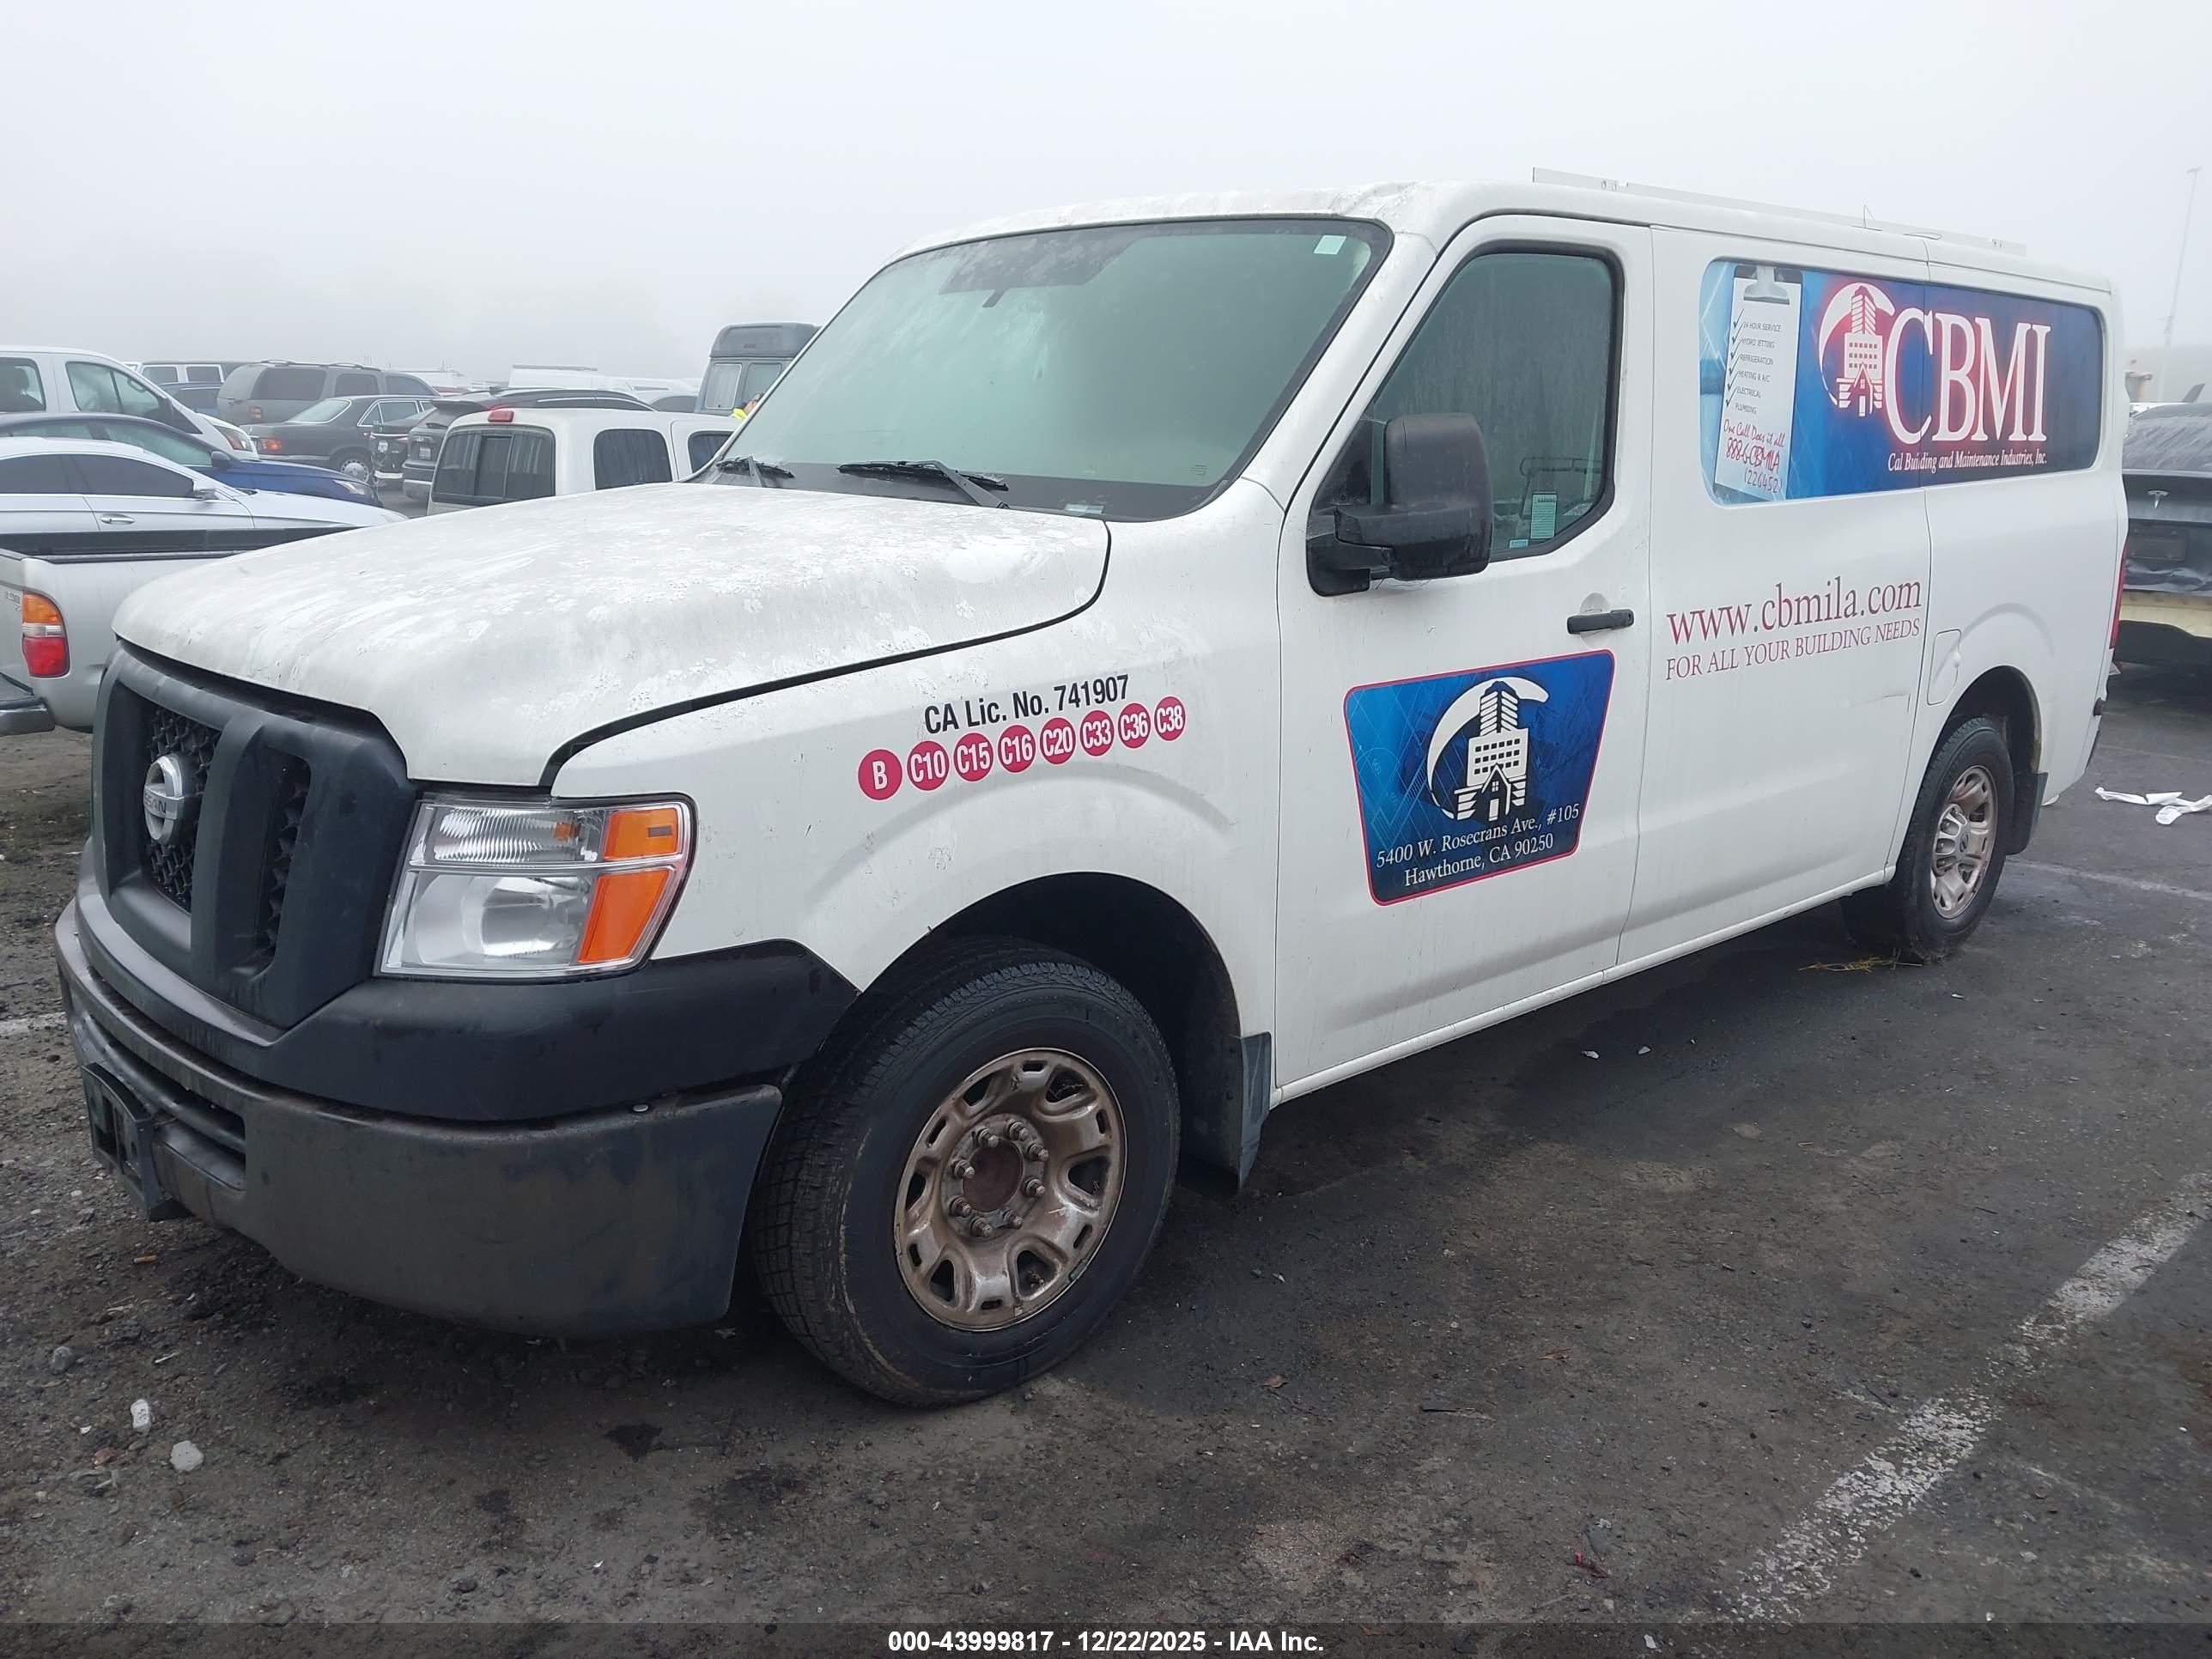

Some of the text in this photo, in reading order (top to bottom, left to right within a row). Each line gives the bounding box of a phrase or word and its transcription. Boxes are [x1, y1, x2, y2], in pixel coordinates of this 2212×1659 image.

[1762, 323, 1782, 331] SERVICE
[1758, 340, 1775, 349] JETTING
[1740, 354, 1773, 366] REFRIGERATION
[1738, 371, 1756, 380] HEATING
[1885, 307, 2051, 445] CBMI
[1736, 386, 1761, 398] ELECTRICAL
[1735, 403, 1757, 414] PLUMBING
[1736, 422, 1751, 437] Call
[1752, 425, 1765, 443] Does
[1774, 433, 1785, 447] all
[1887, 453, 1903, 471] Cal
[1938, 451, 1954, 469] and
[1954, 450, 2000, 468] Maintenance
[2000, 449, 2034, 467] Industries,
[2035, 448, 2047, 464] Inc.
[1667, 575, 1922, 645] www.cbmila.com
[1666, 617, 1921, 681] FOR ALL YOUR BUILDING NEEDS
[924, 674, 1128, 734] CA Lic. No. 741907
[872, 705, 1184, 790] B C10 C15 C16 C20 C33 C36 C38
[1376, 804, 1580, 868] 5400 W. Rosecrans Ave., #105
[1403, 833, 1554, 887] Hawthorne, CA 90250
